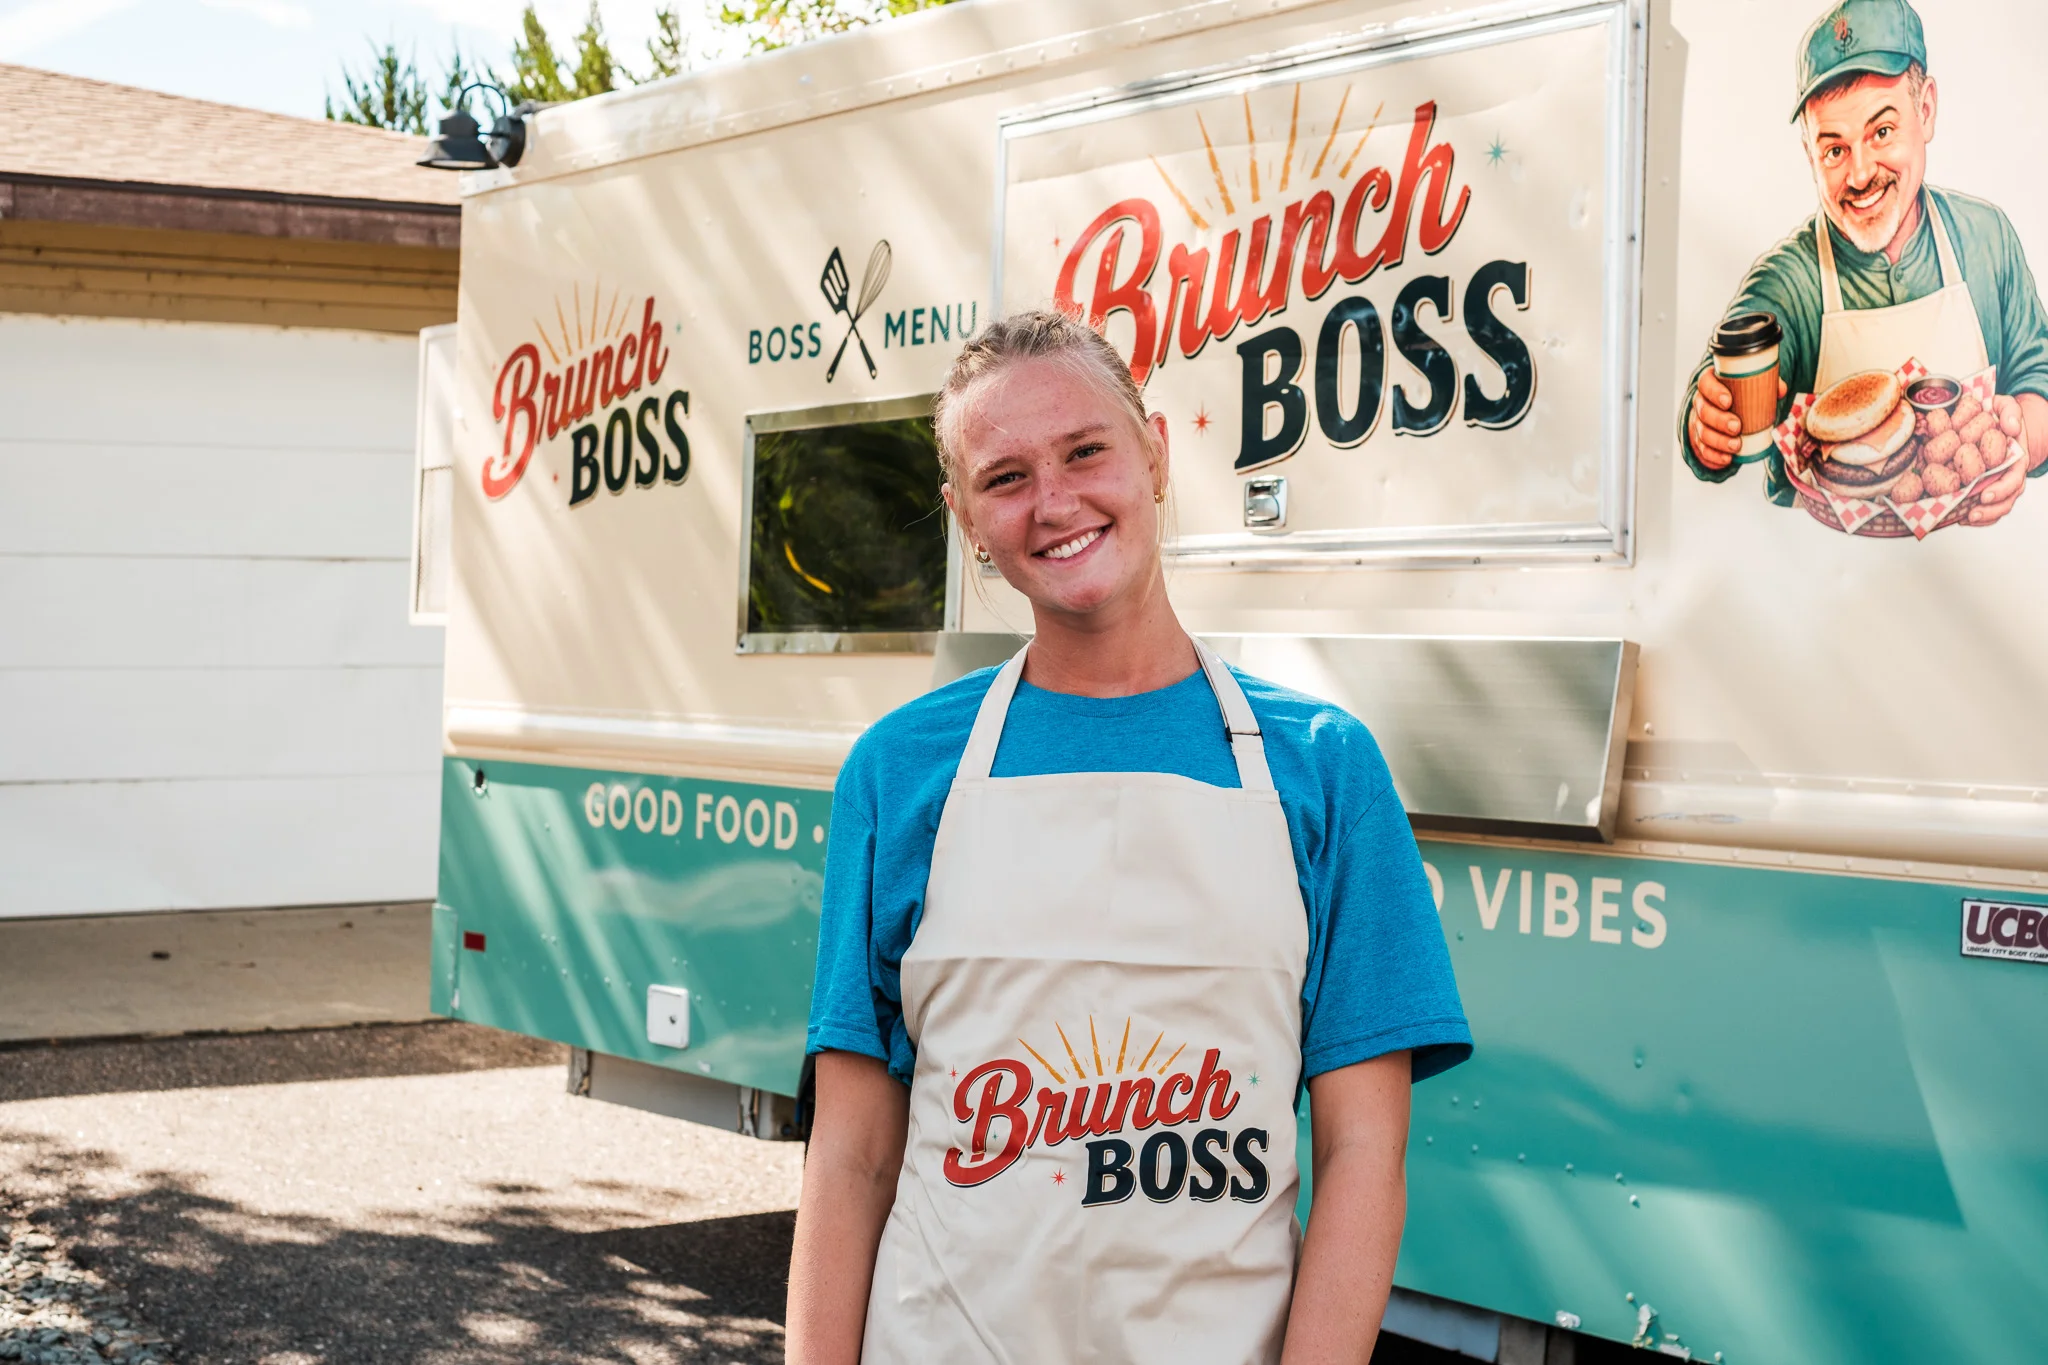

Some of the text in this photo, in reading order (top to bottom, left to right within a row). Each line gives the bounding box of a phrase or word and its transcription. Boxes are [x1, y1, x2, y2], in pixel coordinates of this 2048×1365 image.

[1053, 99, 1471, 388] Brunch
[748, 301, 977, 364] BOSS MENU
[1234, 259, 1537, 475] BOSS
[481, 296, 670, 499] Brunch
[568, 390, 690, 510] BOSS
[584, 782, 798, 850] GOOD FOOD
[1469, 865, 1667, 949] VIBES
[943, 1048, 1240, 1187] Brunch
[1081, 1127, 1269, 1208] BOSS
